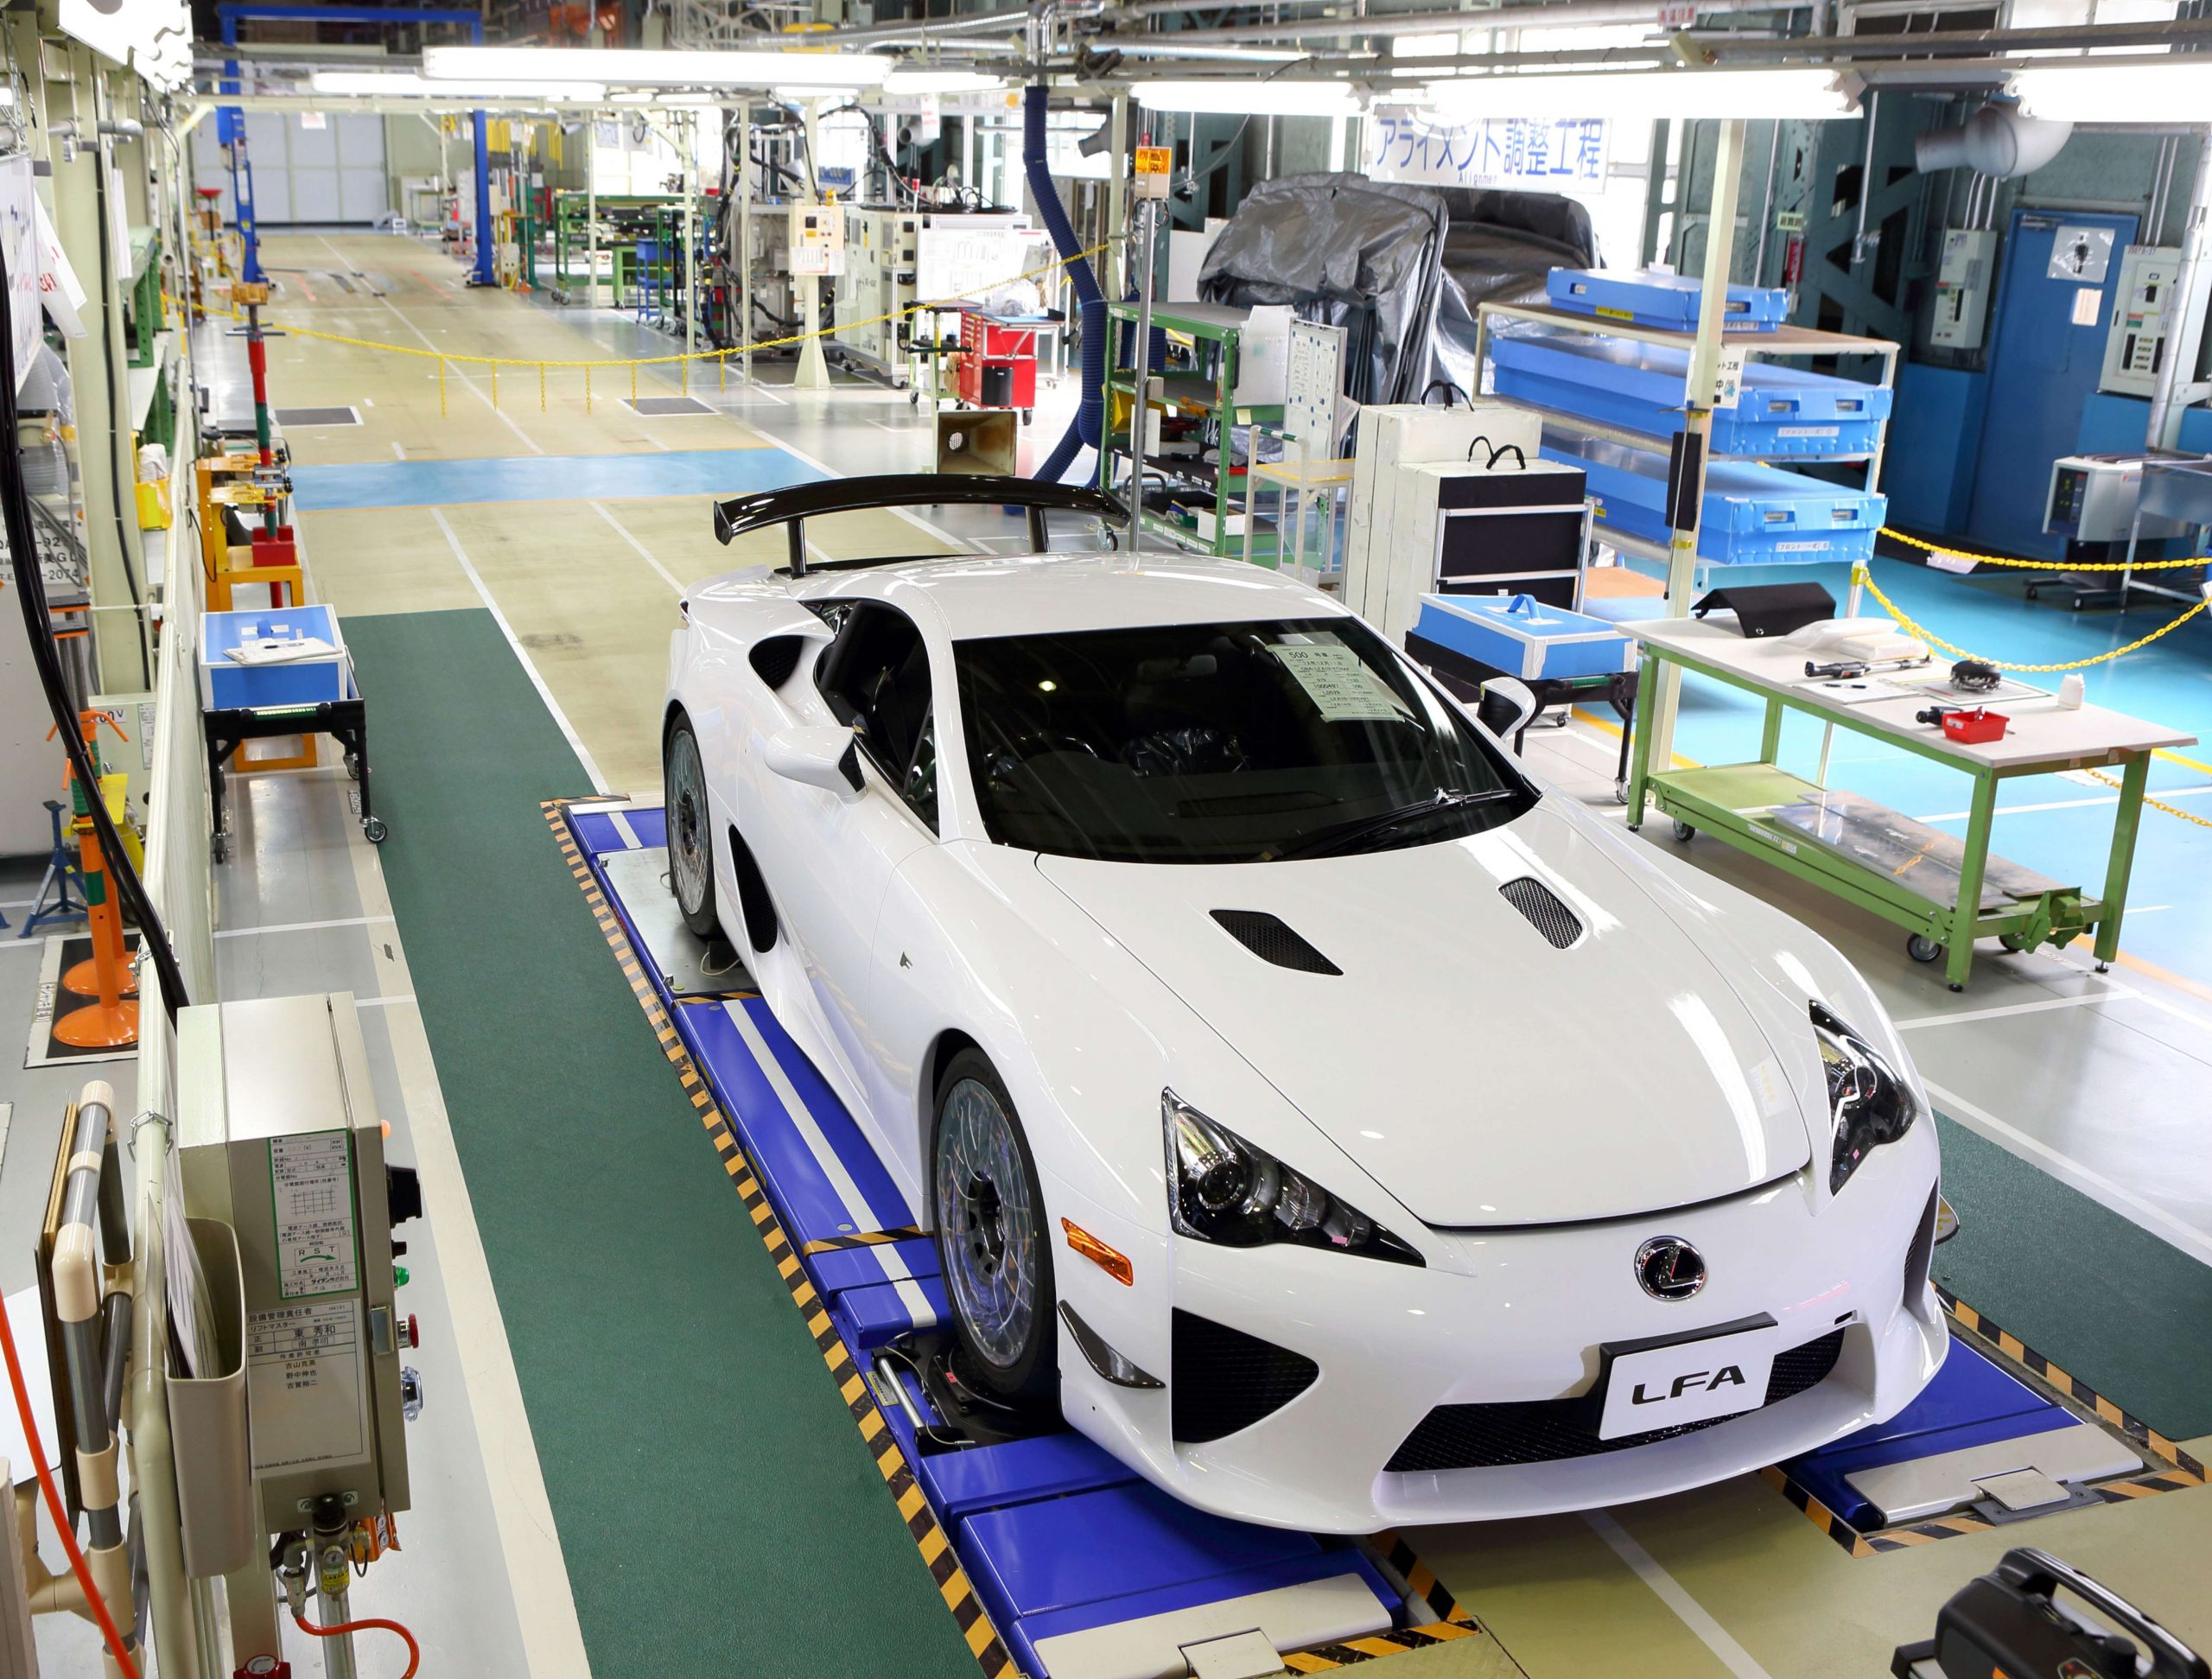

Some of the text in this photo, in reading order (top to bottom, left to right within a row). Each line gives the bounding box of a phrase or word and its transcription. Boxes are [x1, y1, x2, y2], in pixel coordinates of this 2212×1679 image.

[249, 1307, 312, 1322] 設備管理責任者
[251, 1322, 296, 1332] リフトマスター
[1631, 1364, 1745, 1405] LFA
